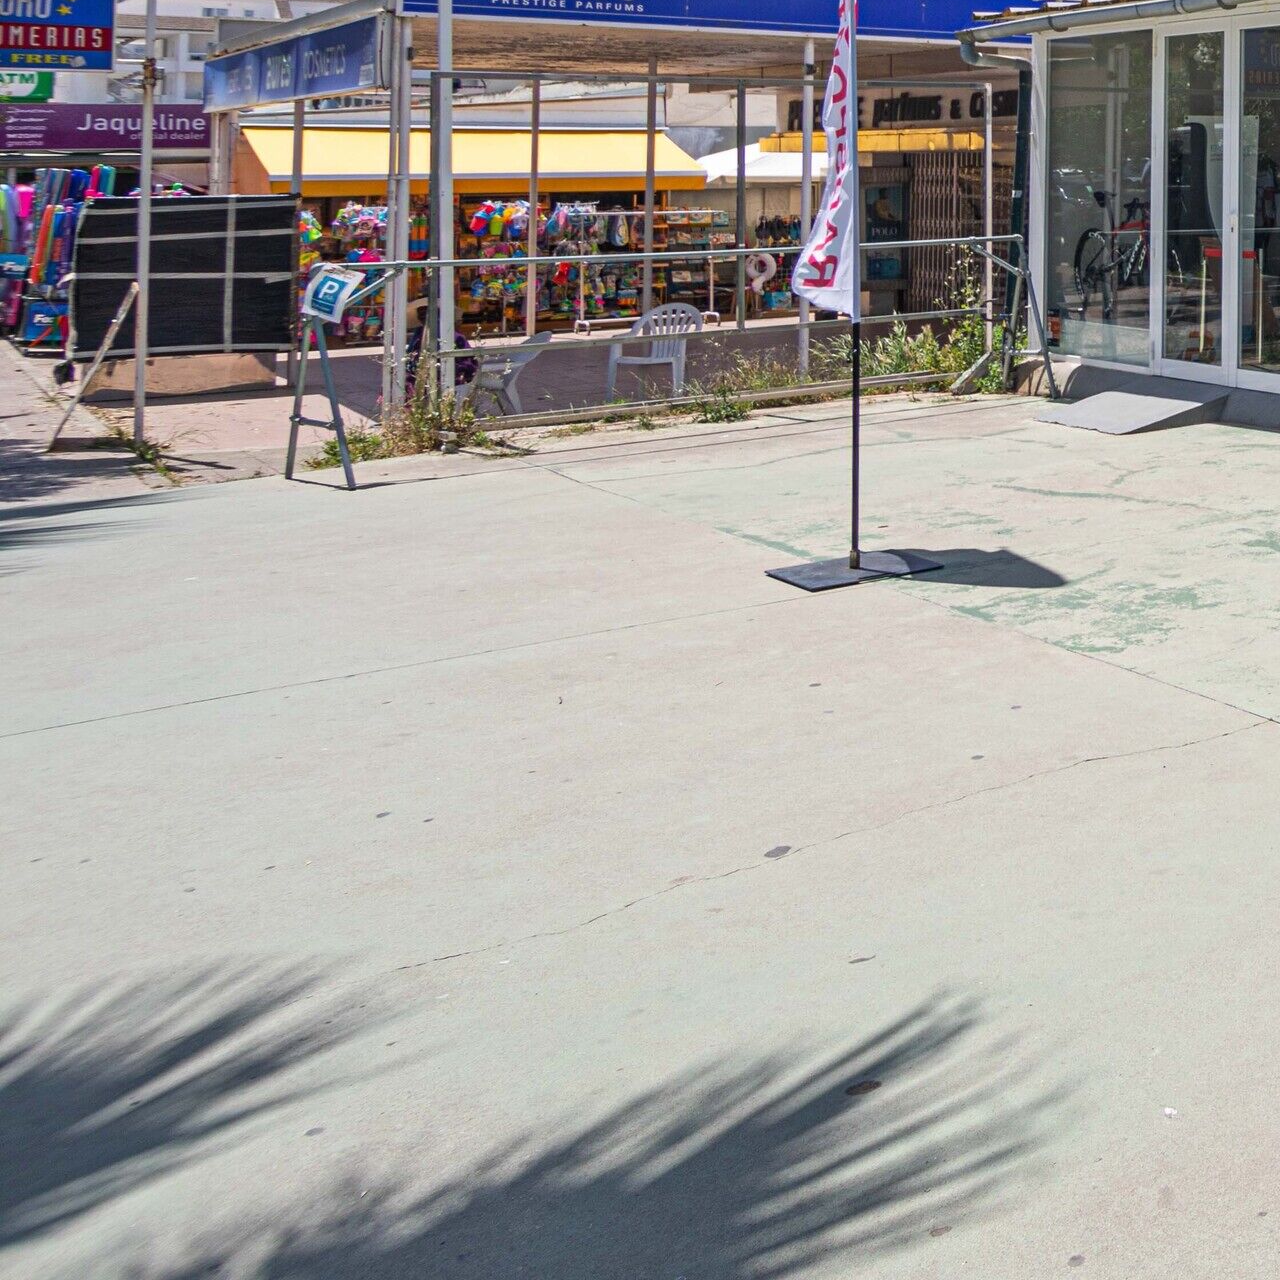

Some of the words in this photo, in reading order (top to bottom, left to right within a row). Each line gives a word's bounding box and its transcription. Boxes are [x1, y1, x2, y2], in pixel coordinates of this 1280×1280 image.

[575, 0, 645, 13] PARFUMS
[0, 24, 103, 48] MERIAS
[169, 131, 205, 141] dealer
[871, 226, 898, 237] POLO
[318, 280, 340, 299] P
